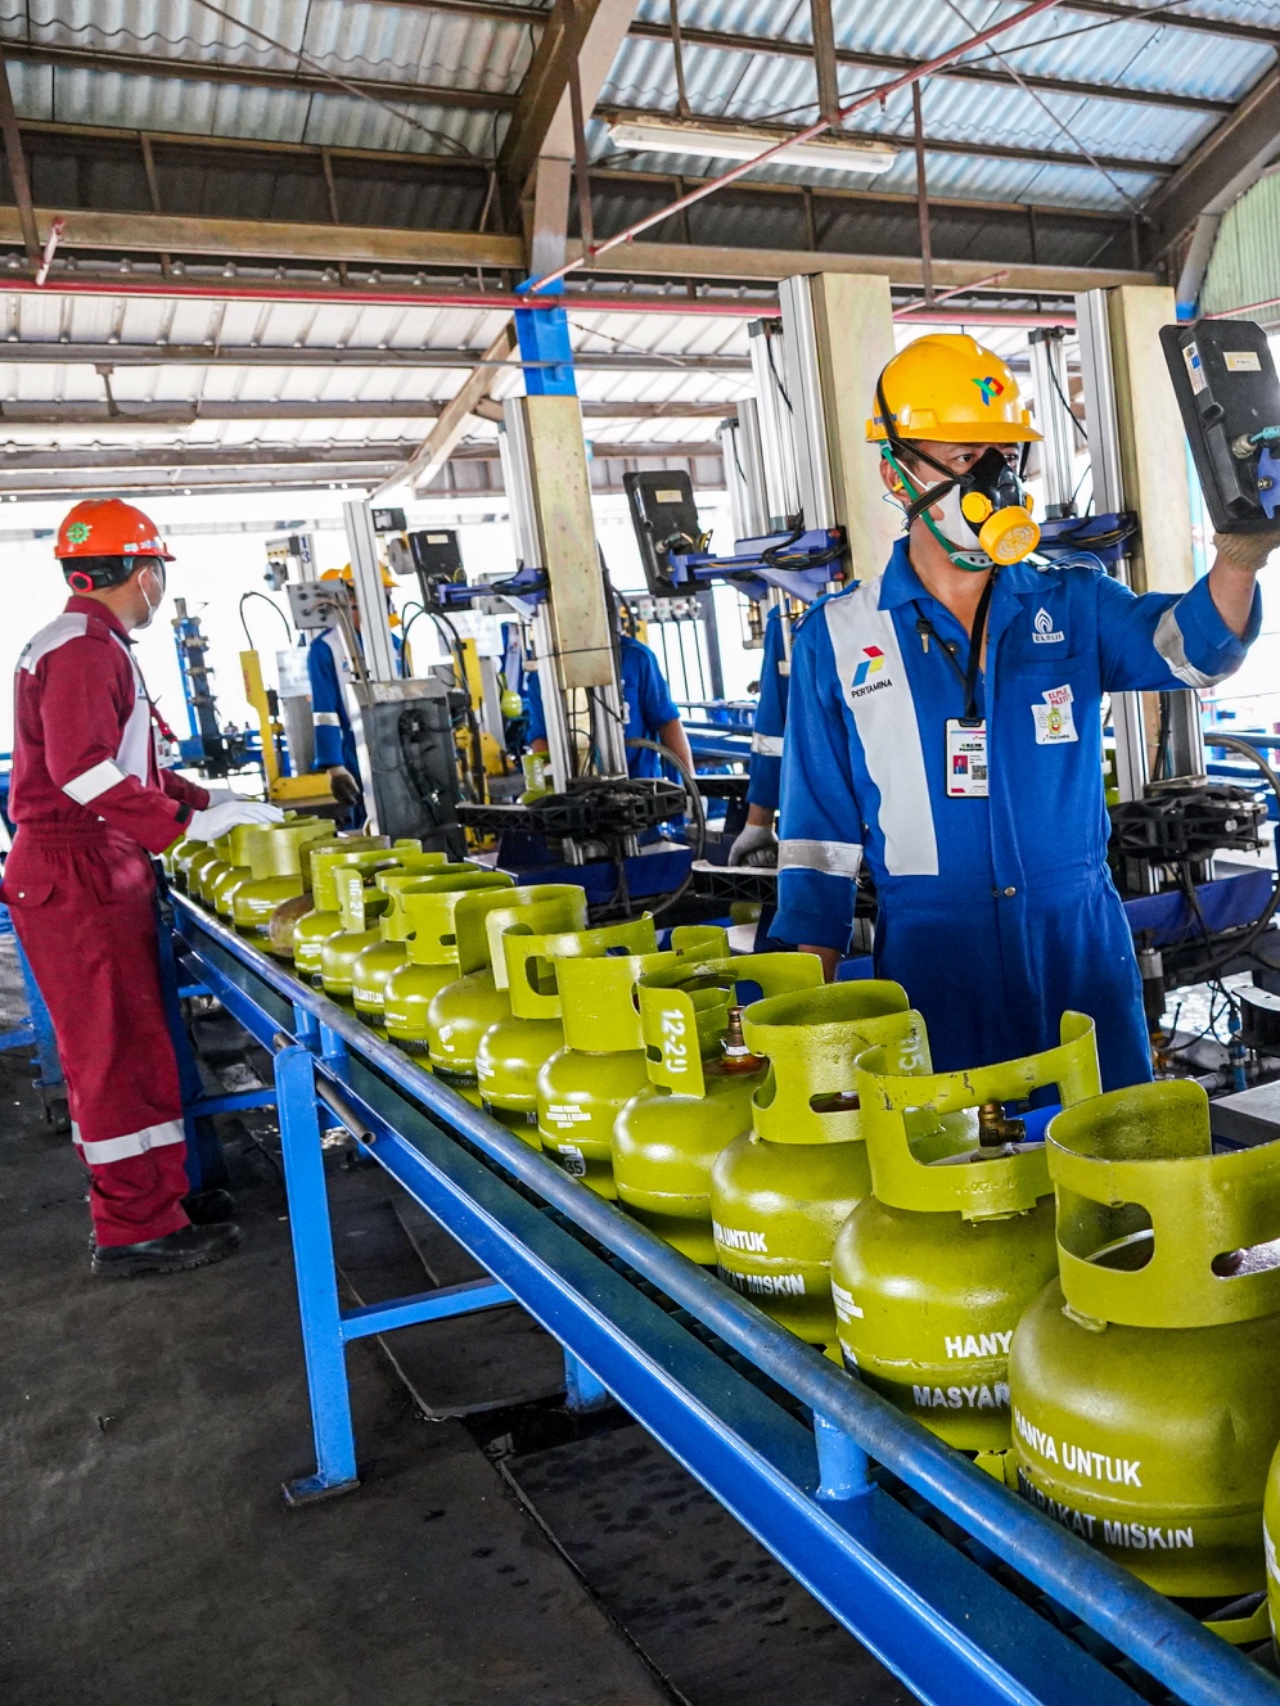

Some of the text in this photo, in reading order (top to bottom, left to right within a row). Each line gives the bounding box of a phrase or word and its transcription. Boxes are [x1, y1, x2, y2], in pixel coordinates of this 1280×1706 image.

[851, 678, 893, 699] PERTAMINA
[724, 1225, 769, 1253] UNTUK
[746, 1272, 806, 1298] MISKIN
[1013, 1405, 1143, 1489] HANYA UNTUK
[1103, 1518, 1195, 1552] MISKIN
